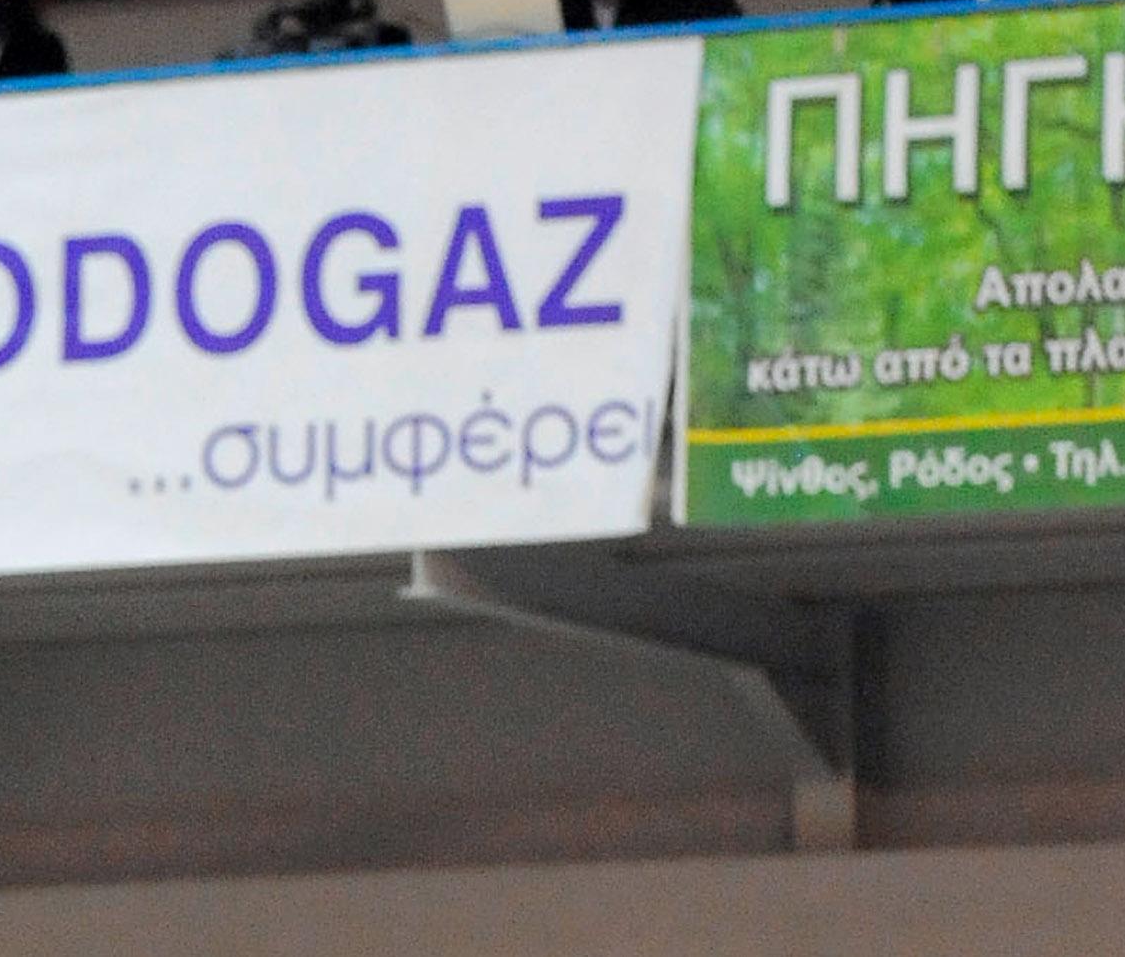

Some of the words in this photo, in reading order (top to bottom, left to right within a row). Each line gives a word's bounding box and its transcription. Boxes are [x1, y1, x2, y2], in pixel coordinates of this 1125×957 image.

[766, 53, 1125, 207] ΠΗΓ
[747, 347, 862, 392] κάτω
[875, 334, 971, 384] από
[982, 342, 1032, 377] τα
[889, 446, 1014, 494] Ρόδος
